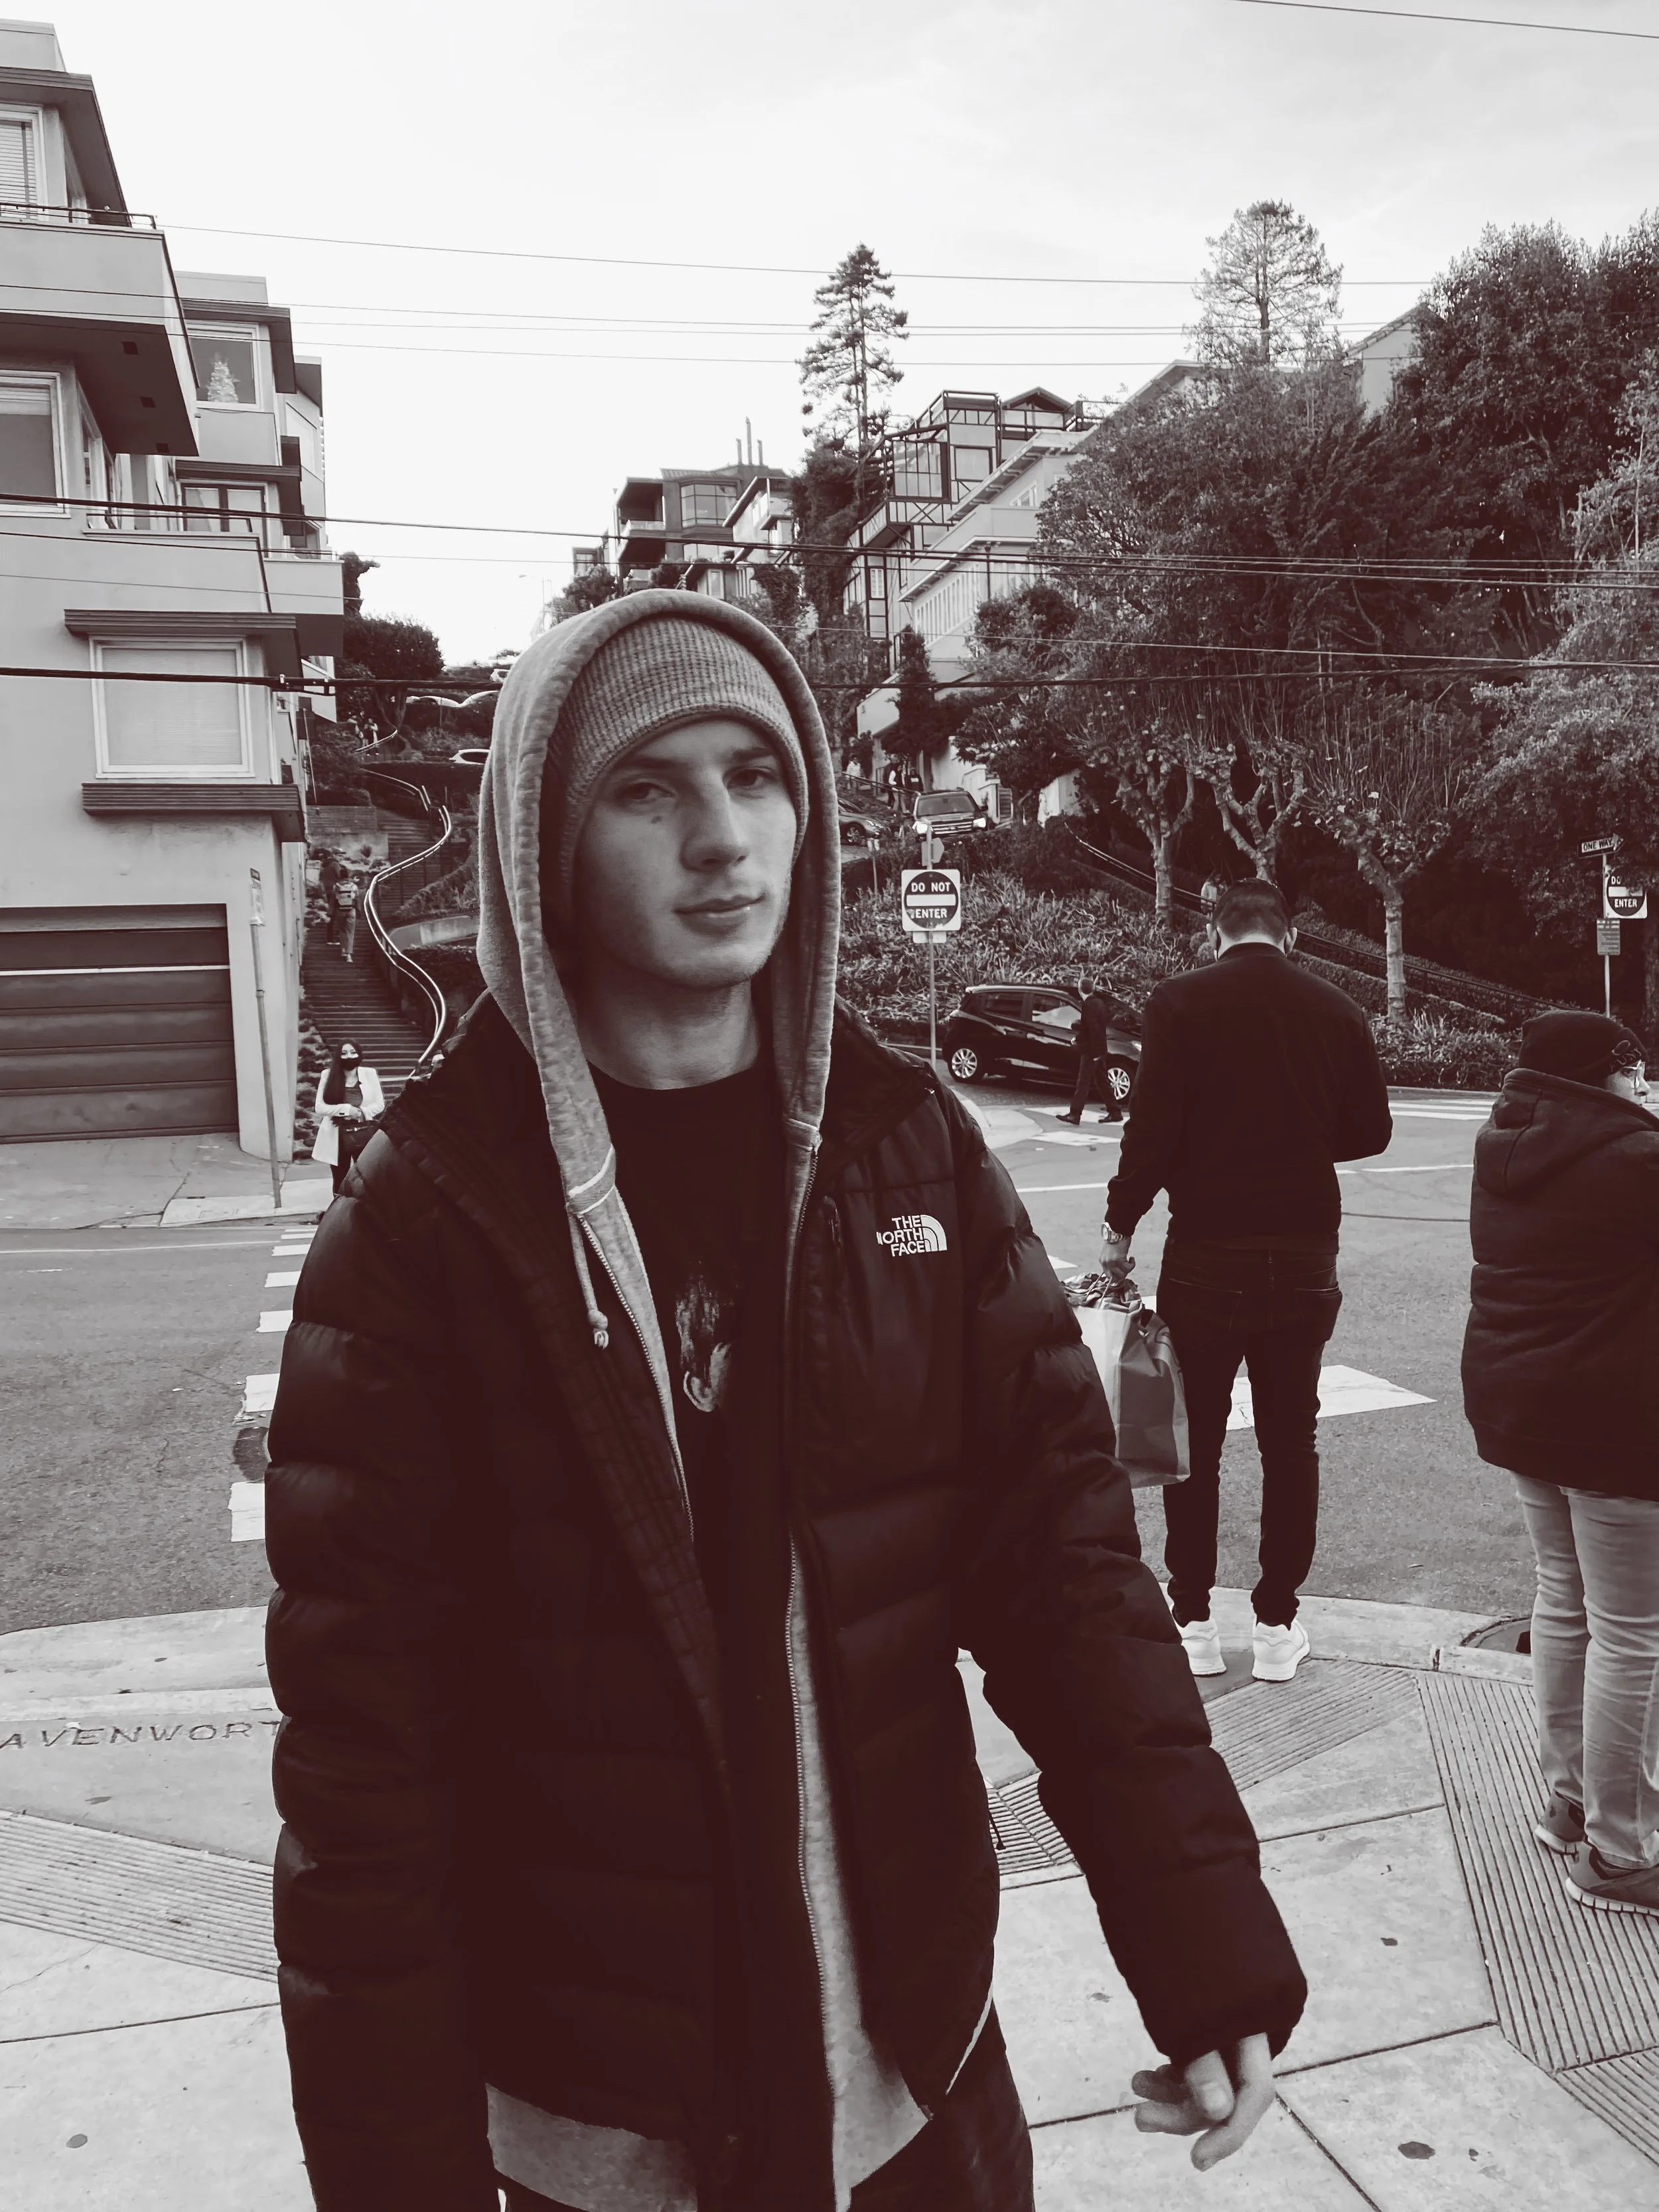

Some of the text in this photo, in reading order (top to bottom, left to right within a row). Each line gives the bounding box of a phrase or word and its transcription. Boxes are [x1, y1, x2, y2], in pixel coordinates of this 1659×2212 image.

[1583, 838, 1613, 851] ONE WAY
[911, 882, 951, 892] DO NOT
[1614, 898, 1638, 908] ENTER
[915, 908, 948, 919] ENTER
[891, 1215, 922, 1230] THE
[891, 1240, 925, 1257] FACE
